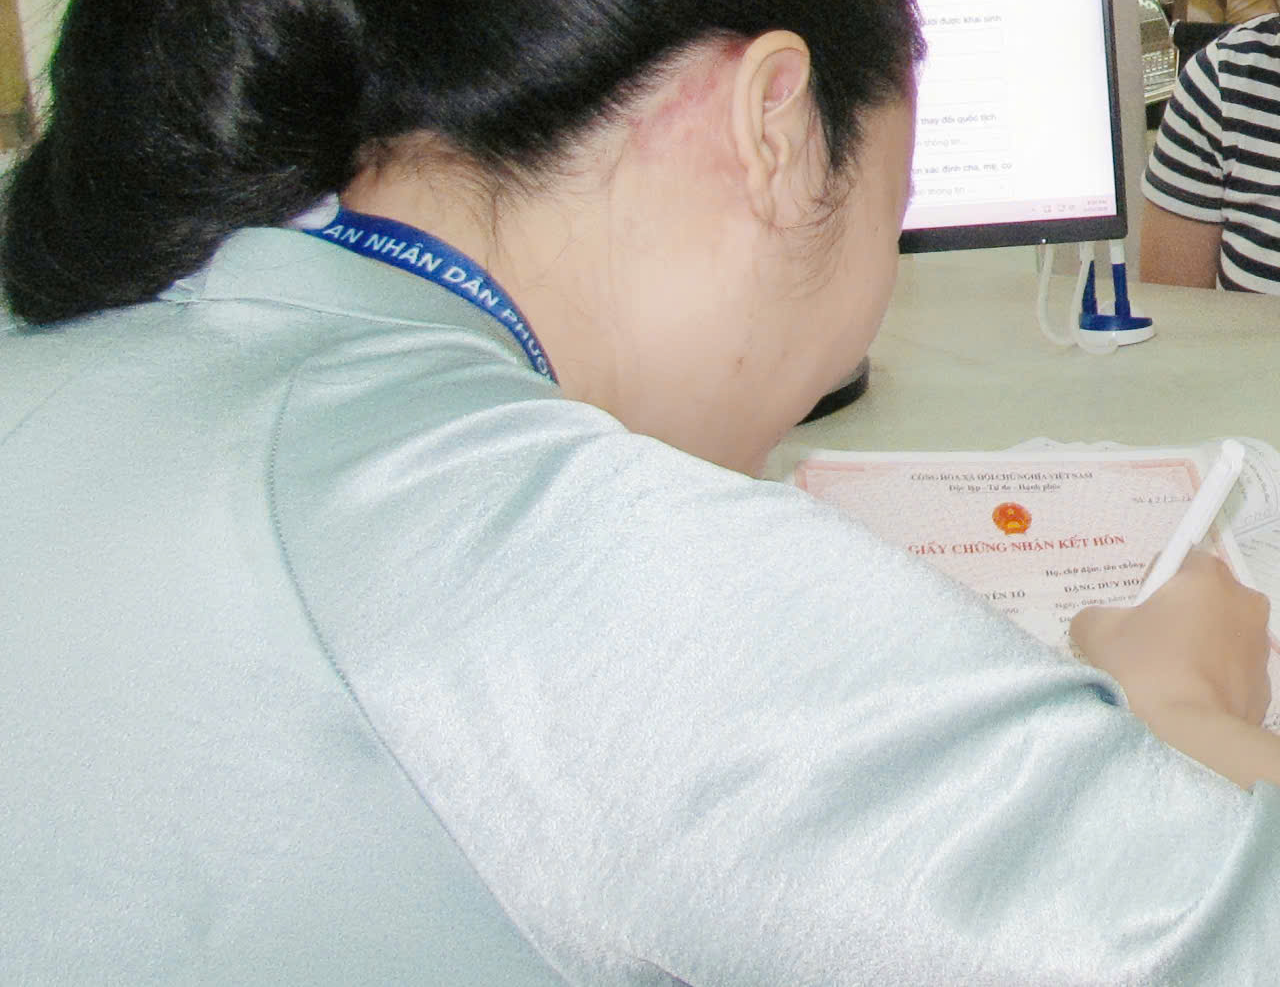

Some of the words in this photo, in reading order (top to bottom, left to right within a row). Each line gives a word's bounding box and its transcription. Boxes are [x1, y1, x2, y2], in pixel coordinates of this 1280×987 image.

[323, 223, 364, 244] AN
[364, 233, 441, 273] NHÂN
[443, 266, 499, 307] DÂN
[952, 538, 1008, 555] CHỨNG
[1009, 537, 1055, 554] NHẬN
[1058, 533, 1090, 551] KẾT
[1093, 532, 1126, 546] HÔN
